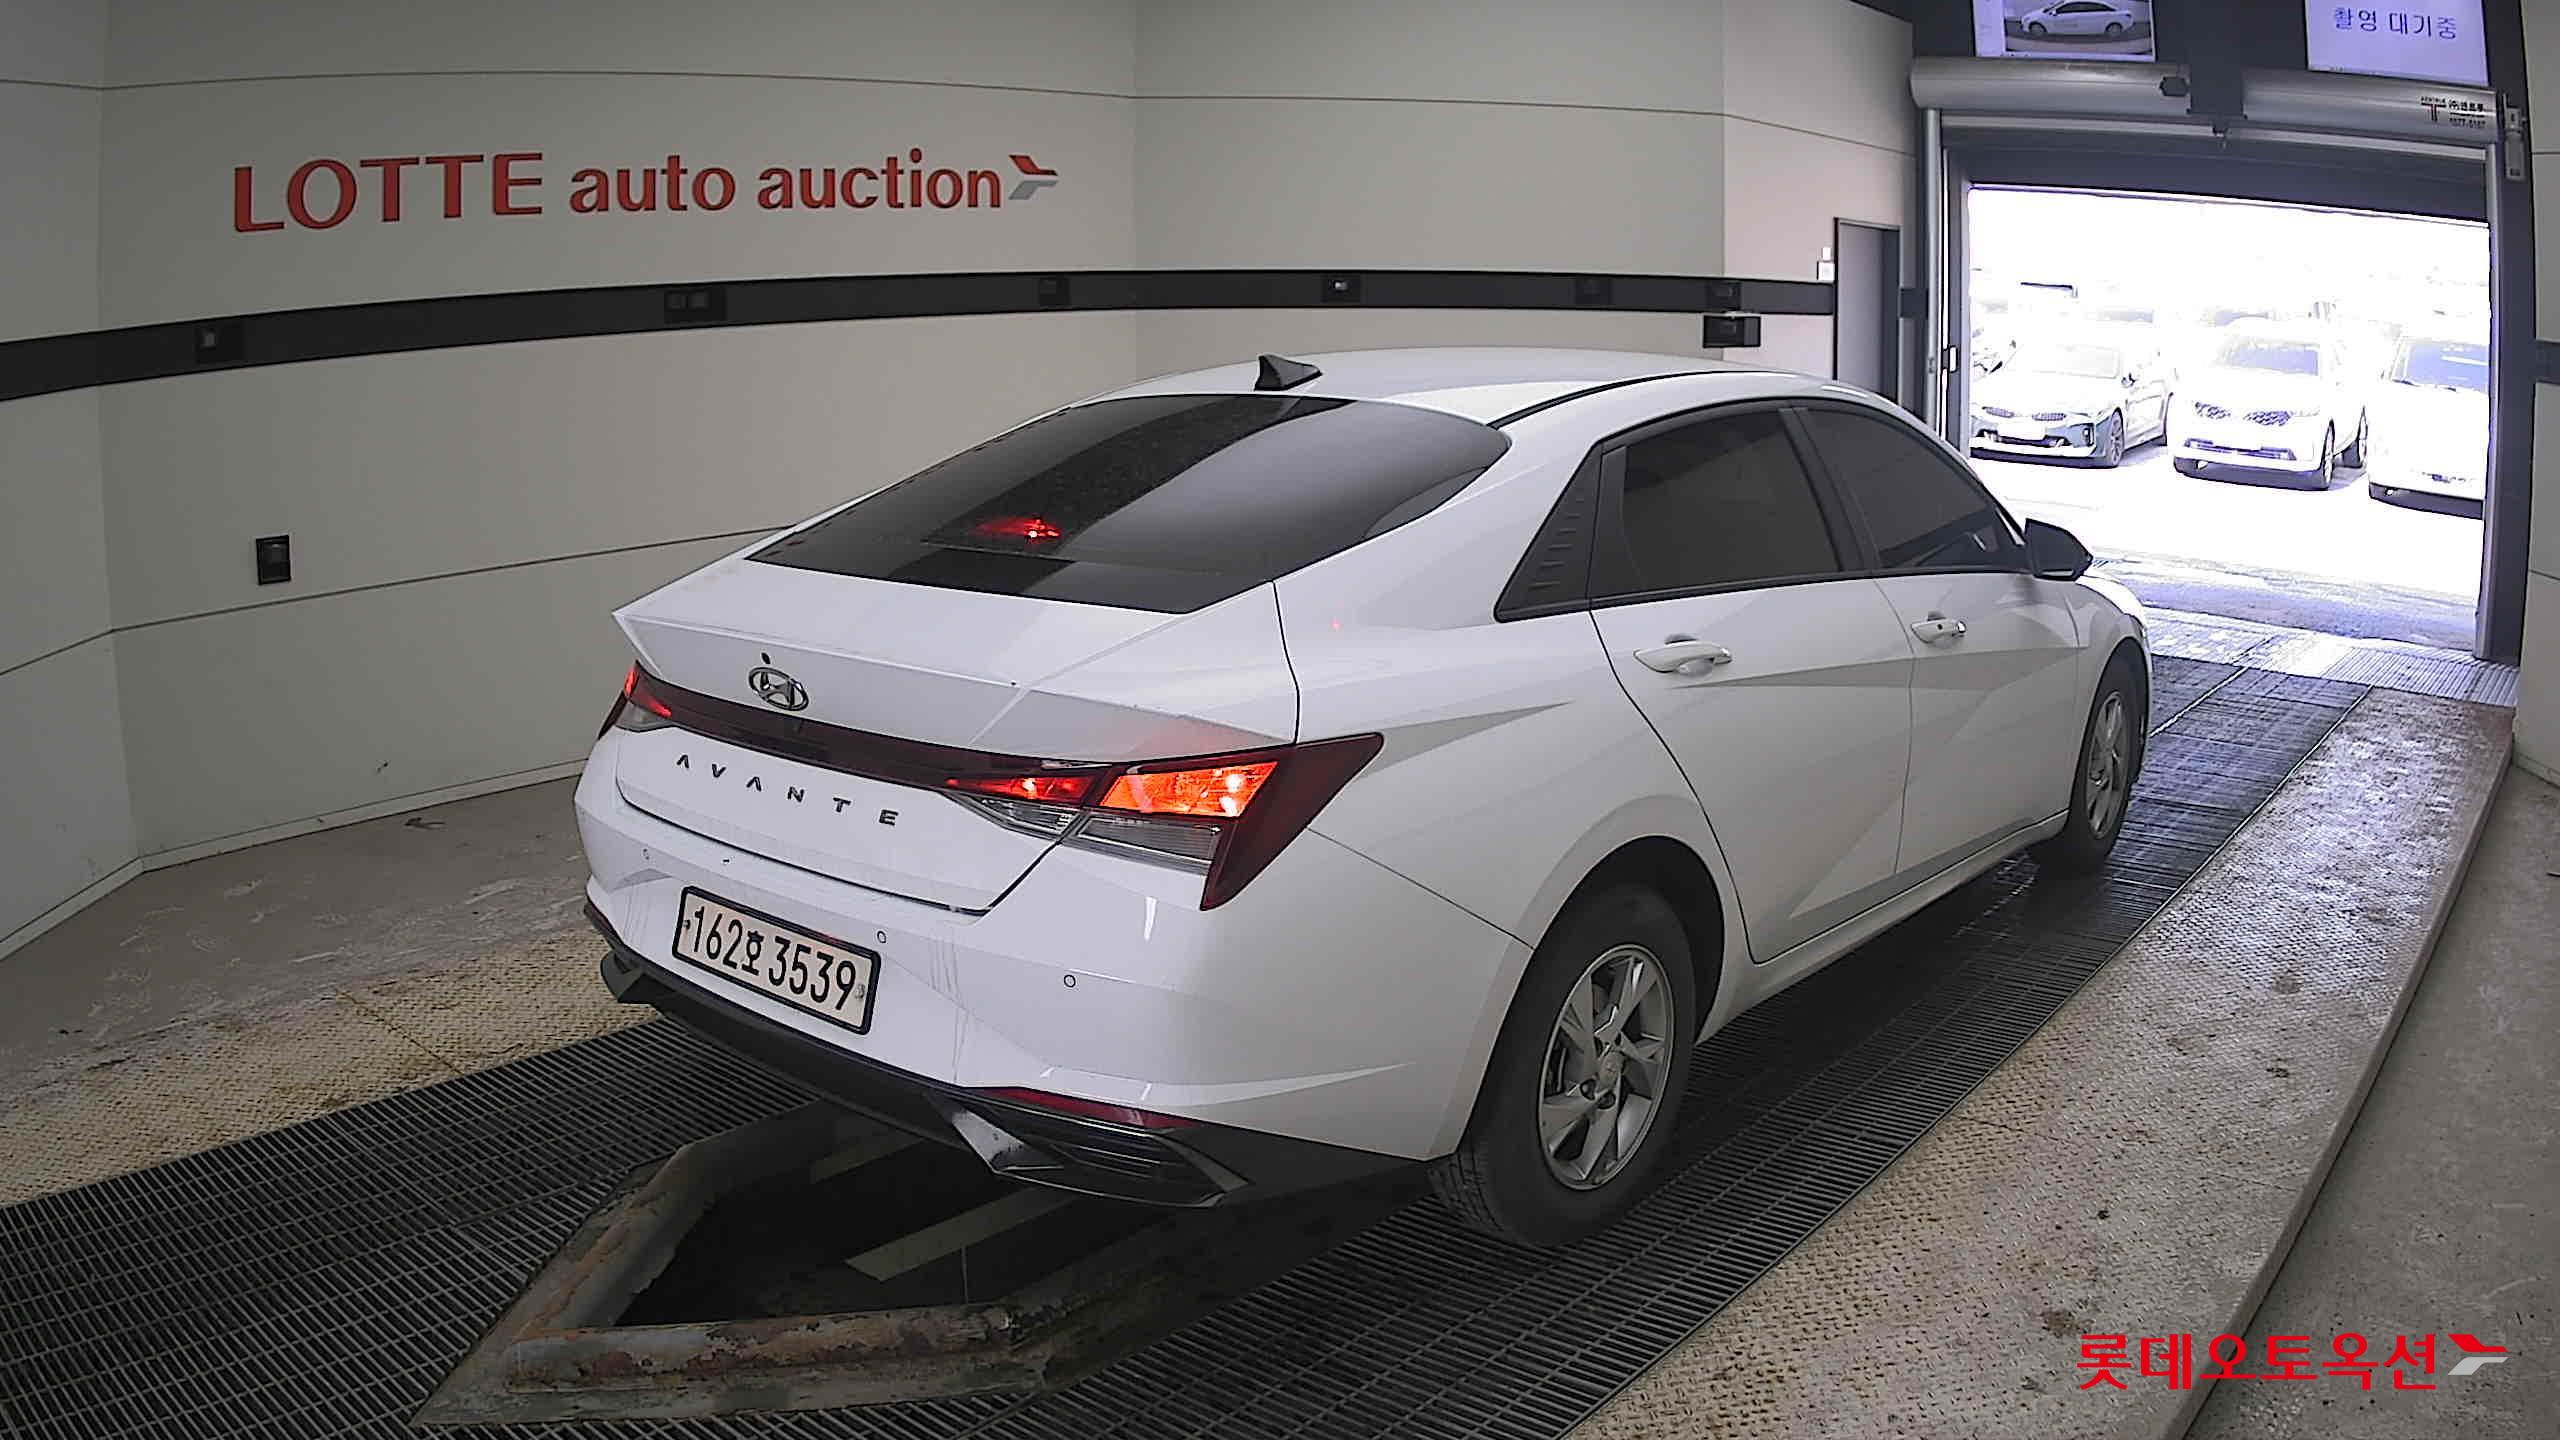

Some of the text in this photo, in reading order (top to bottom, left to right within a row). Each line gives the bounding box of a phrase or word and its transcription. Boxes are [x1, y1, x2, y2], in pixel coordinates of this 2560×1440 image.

[2335, 7, 2457, 40] 촬영 대기중
[234, 148, 1002, 232] LOTTE auto auction
[676, 754, 899, 826] AVANTE
[694, 905, 857, 1011] 162호 3539
